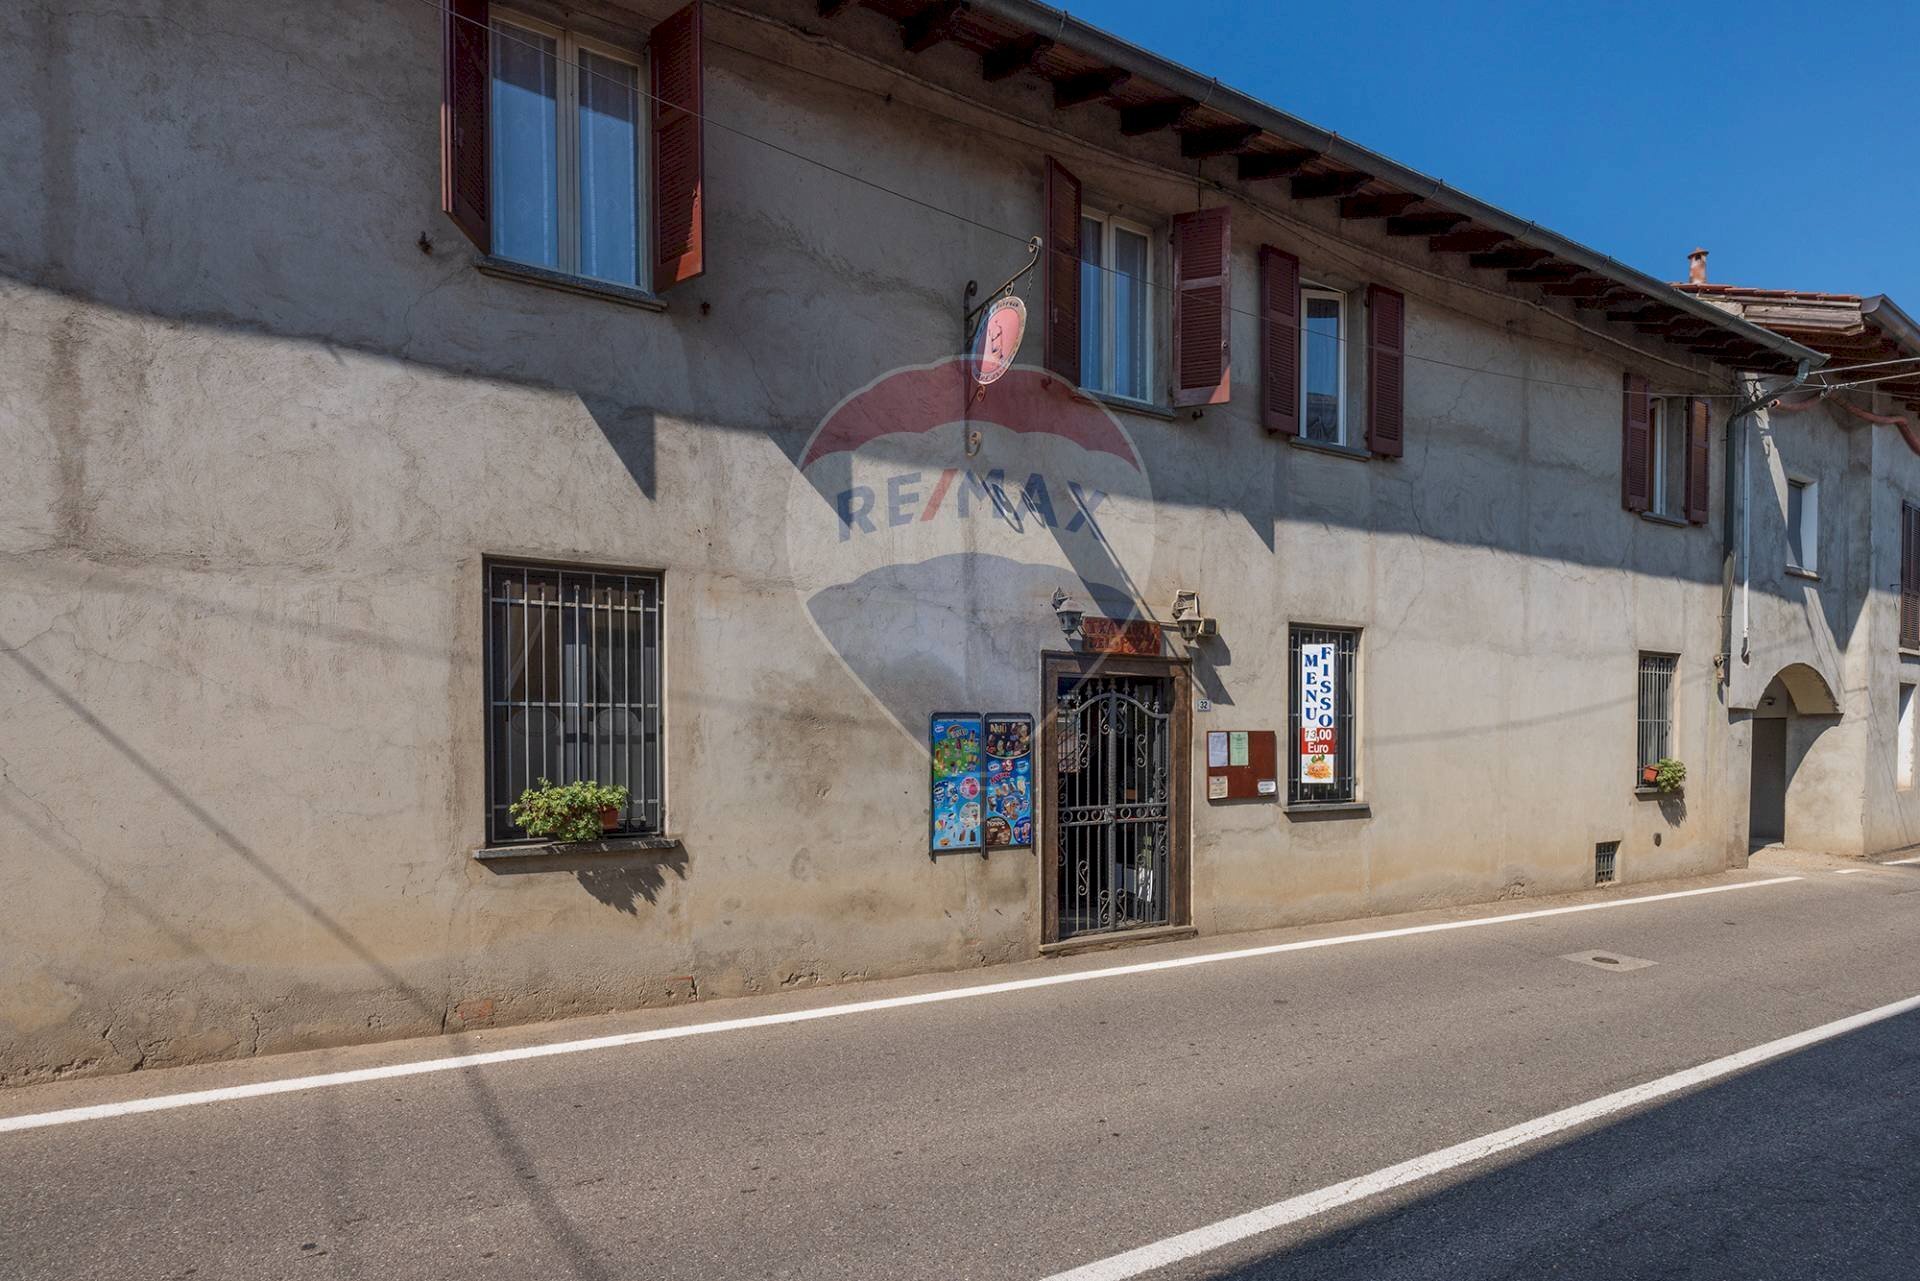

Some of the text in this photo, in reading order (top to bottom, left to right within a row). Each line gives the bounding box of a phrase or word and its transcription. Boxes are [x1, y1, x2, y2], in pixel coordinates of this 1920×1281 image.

[1304, 654, 1319, 721] MENU
[1318, 646, 1333, 728] FISSO
[1307, 742, 1329, 753] Euro
